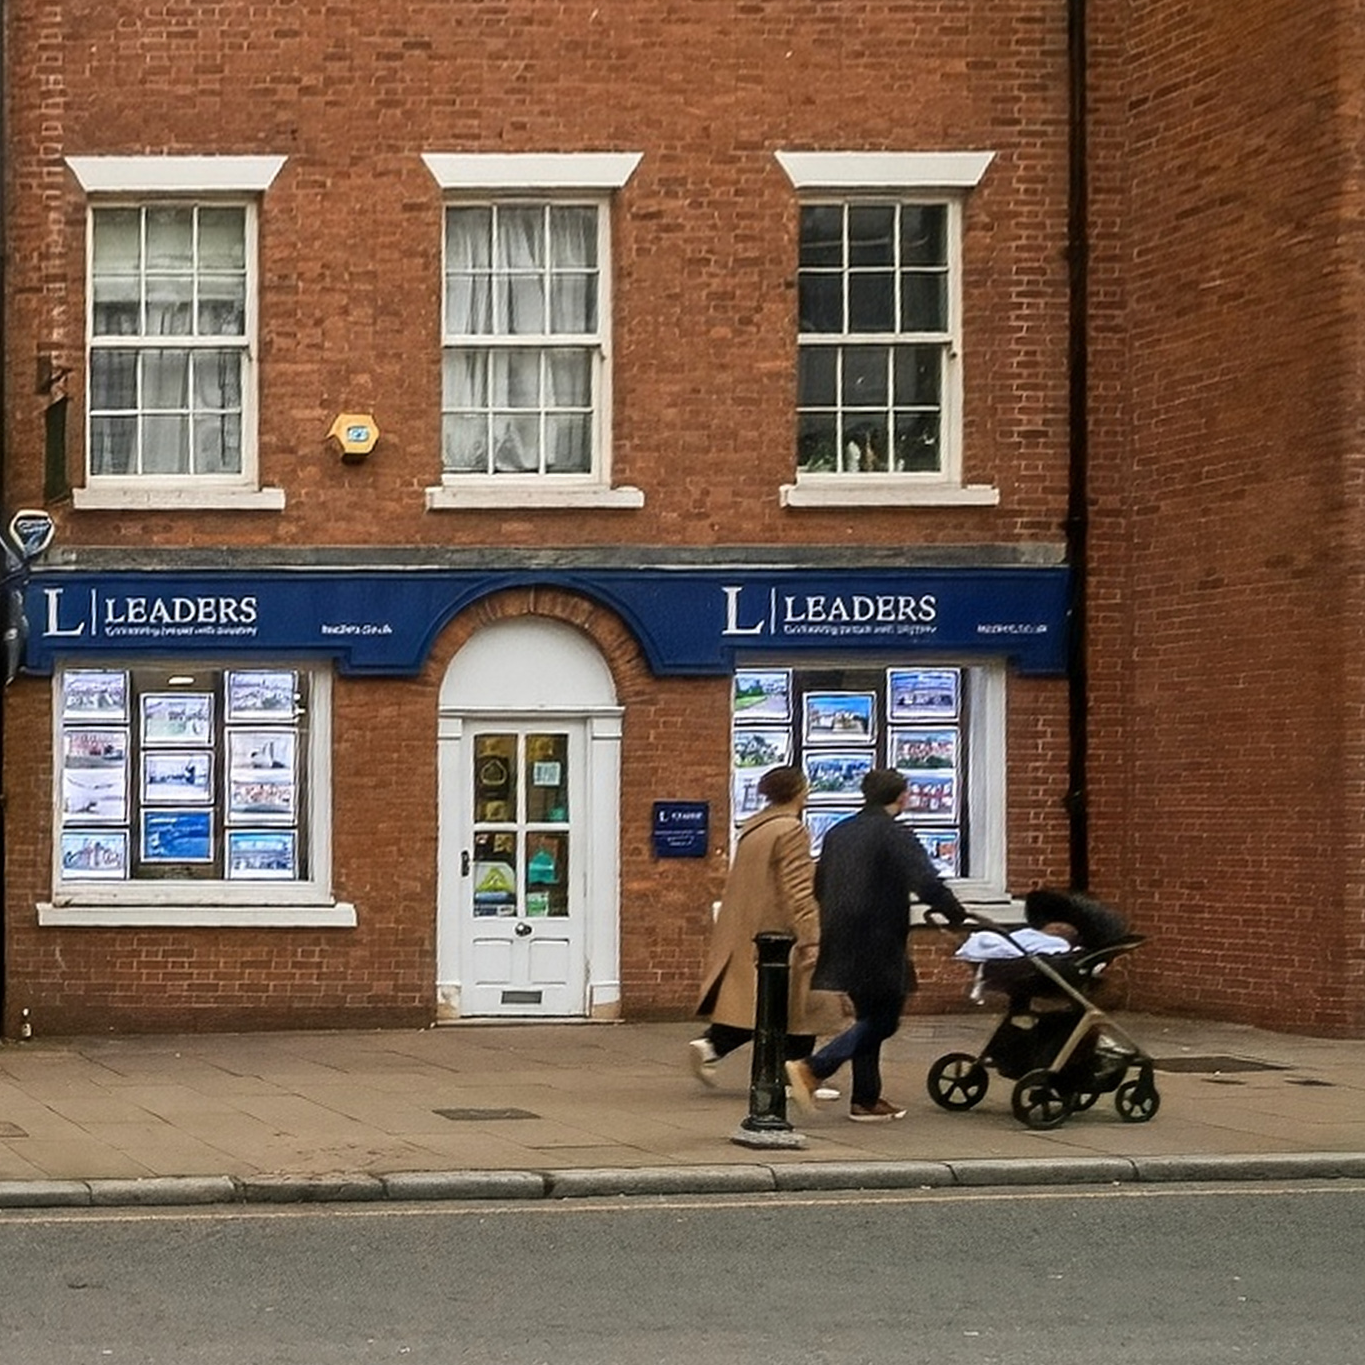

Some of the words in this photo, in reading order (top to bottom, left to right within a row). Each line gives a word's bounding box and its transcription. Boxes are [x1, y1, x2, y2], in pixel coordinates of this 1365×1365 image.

[42, 587, 85, 636] L
[104, 596, 258, 624] LEADERS
[721, 586, 765, 636] L
[783, 594, 937, 622] LEADERS
